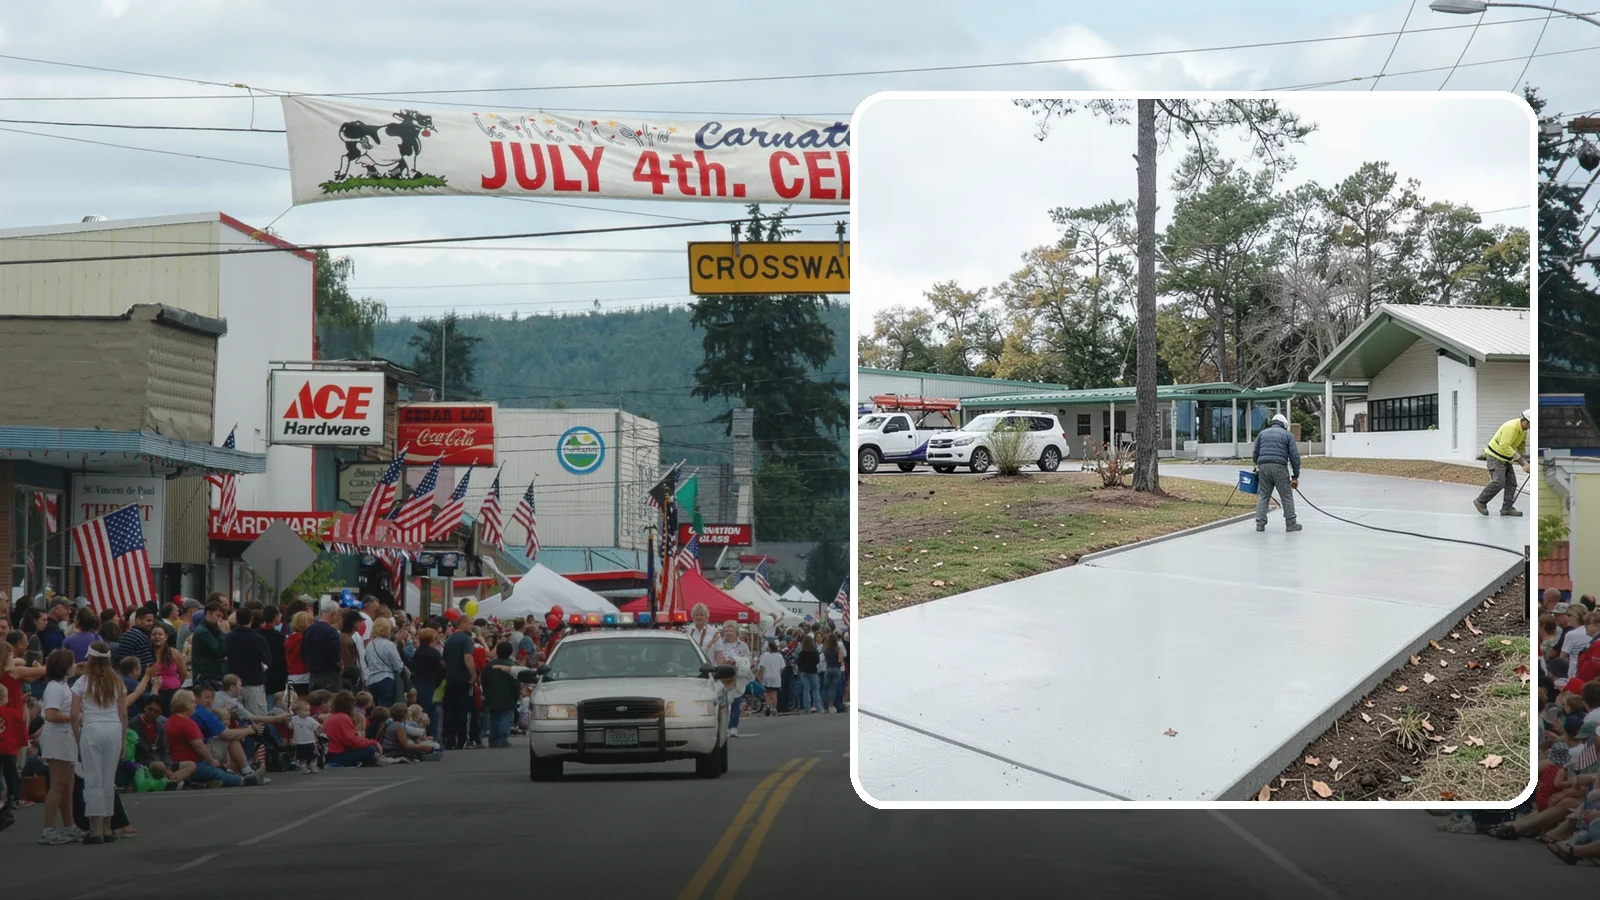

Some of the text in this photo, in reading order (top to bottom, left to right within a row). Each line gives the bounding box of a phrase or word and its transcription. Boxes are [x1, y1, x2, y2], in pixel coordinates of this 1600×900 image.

[694, 121, 850, 150] Carnat
[481, 141, 604, 193] JULY
[631, 150, 746, 198] 4th.
[696, 254, 850, 280] CROSSWA
[282, 380, 373, 420] ACE
[405, 409, 485, 422] CEDAR LOG
[283, 421, 371, 436] Hardware
[416, 428, 477, 447] Coca-Cola
[83, 484, 155, 495] St. Vincent de Paul
[688, 526, 741, 535] CRNATION
[699, 535, 730, 543] GLASS
